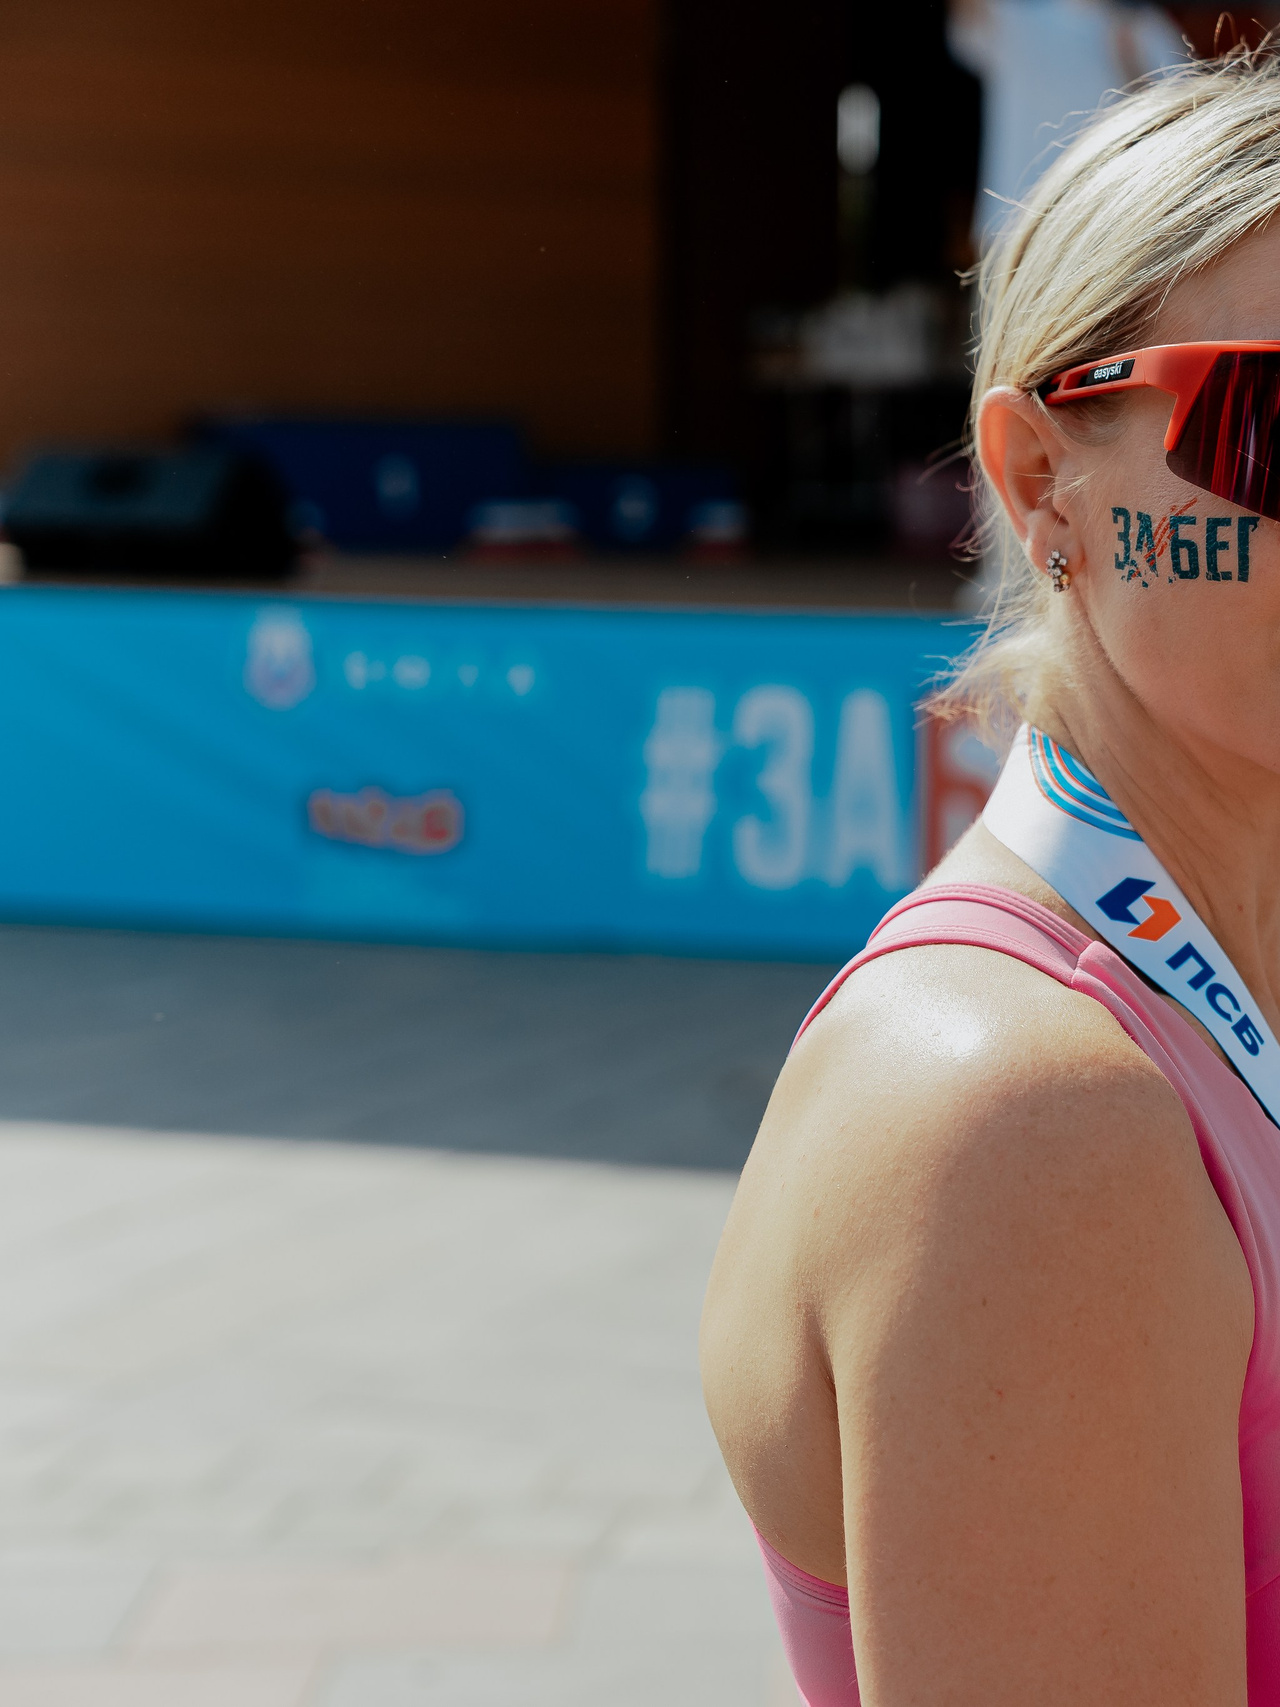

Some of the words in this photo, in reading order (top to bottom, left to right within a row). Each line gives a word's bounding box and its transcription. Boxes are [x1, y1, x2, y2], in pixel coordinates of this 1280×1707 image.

[1094, 361, 1124, 380] easyski
[1110, 505, 1261, 587] ЗАБЕГ
[1165, 941, 1264, 1057] ПСБ
